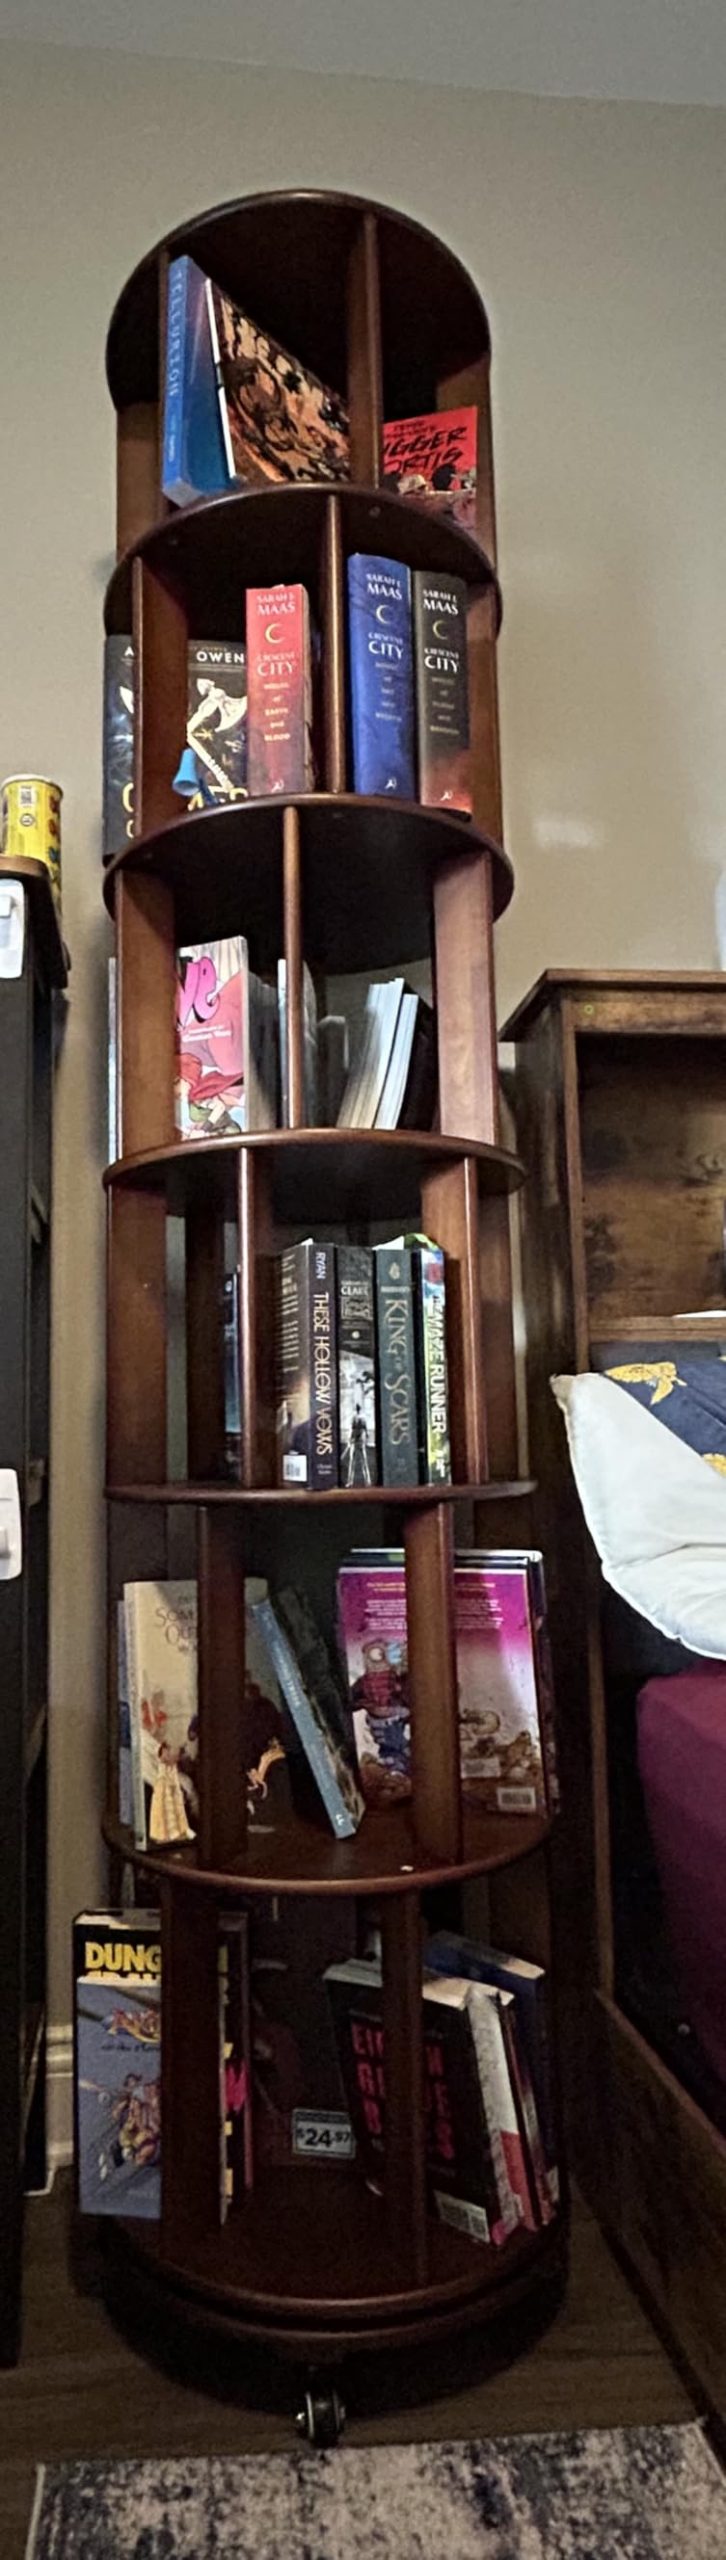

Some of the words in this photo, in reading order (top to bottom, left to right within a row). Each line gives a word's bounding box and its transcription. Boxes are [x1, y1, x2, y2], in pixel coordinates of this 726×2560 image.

[367, 583, 403, 600] MAAS
[257, 601, 296, 615] MAAS
[423, 599, 459, 616] MAAS
[195, 650, 244, 664] OWEN
[368, 641, 403, 660] CITY
[424, 656, 459, 675] CITY
[257, 662, 296, 676] CITY
[316, 1250, 327, 1280] RYAN
[313, 1291, 331, 1333] THESE
[384, 1298, 410, 1354] KING
[428, 1313, 446, 1363] MAZE
[313, 1336, 332, 1404] HOLLOW
[384, 1373, 412, 1445] SCARS
[430, 1364, 447, 1434] RUNNER
[316, 1406, 333, 1456] VOWS
